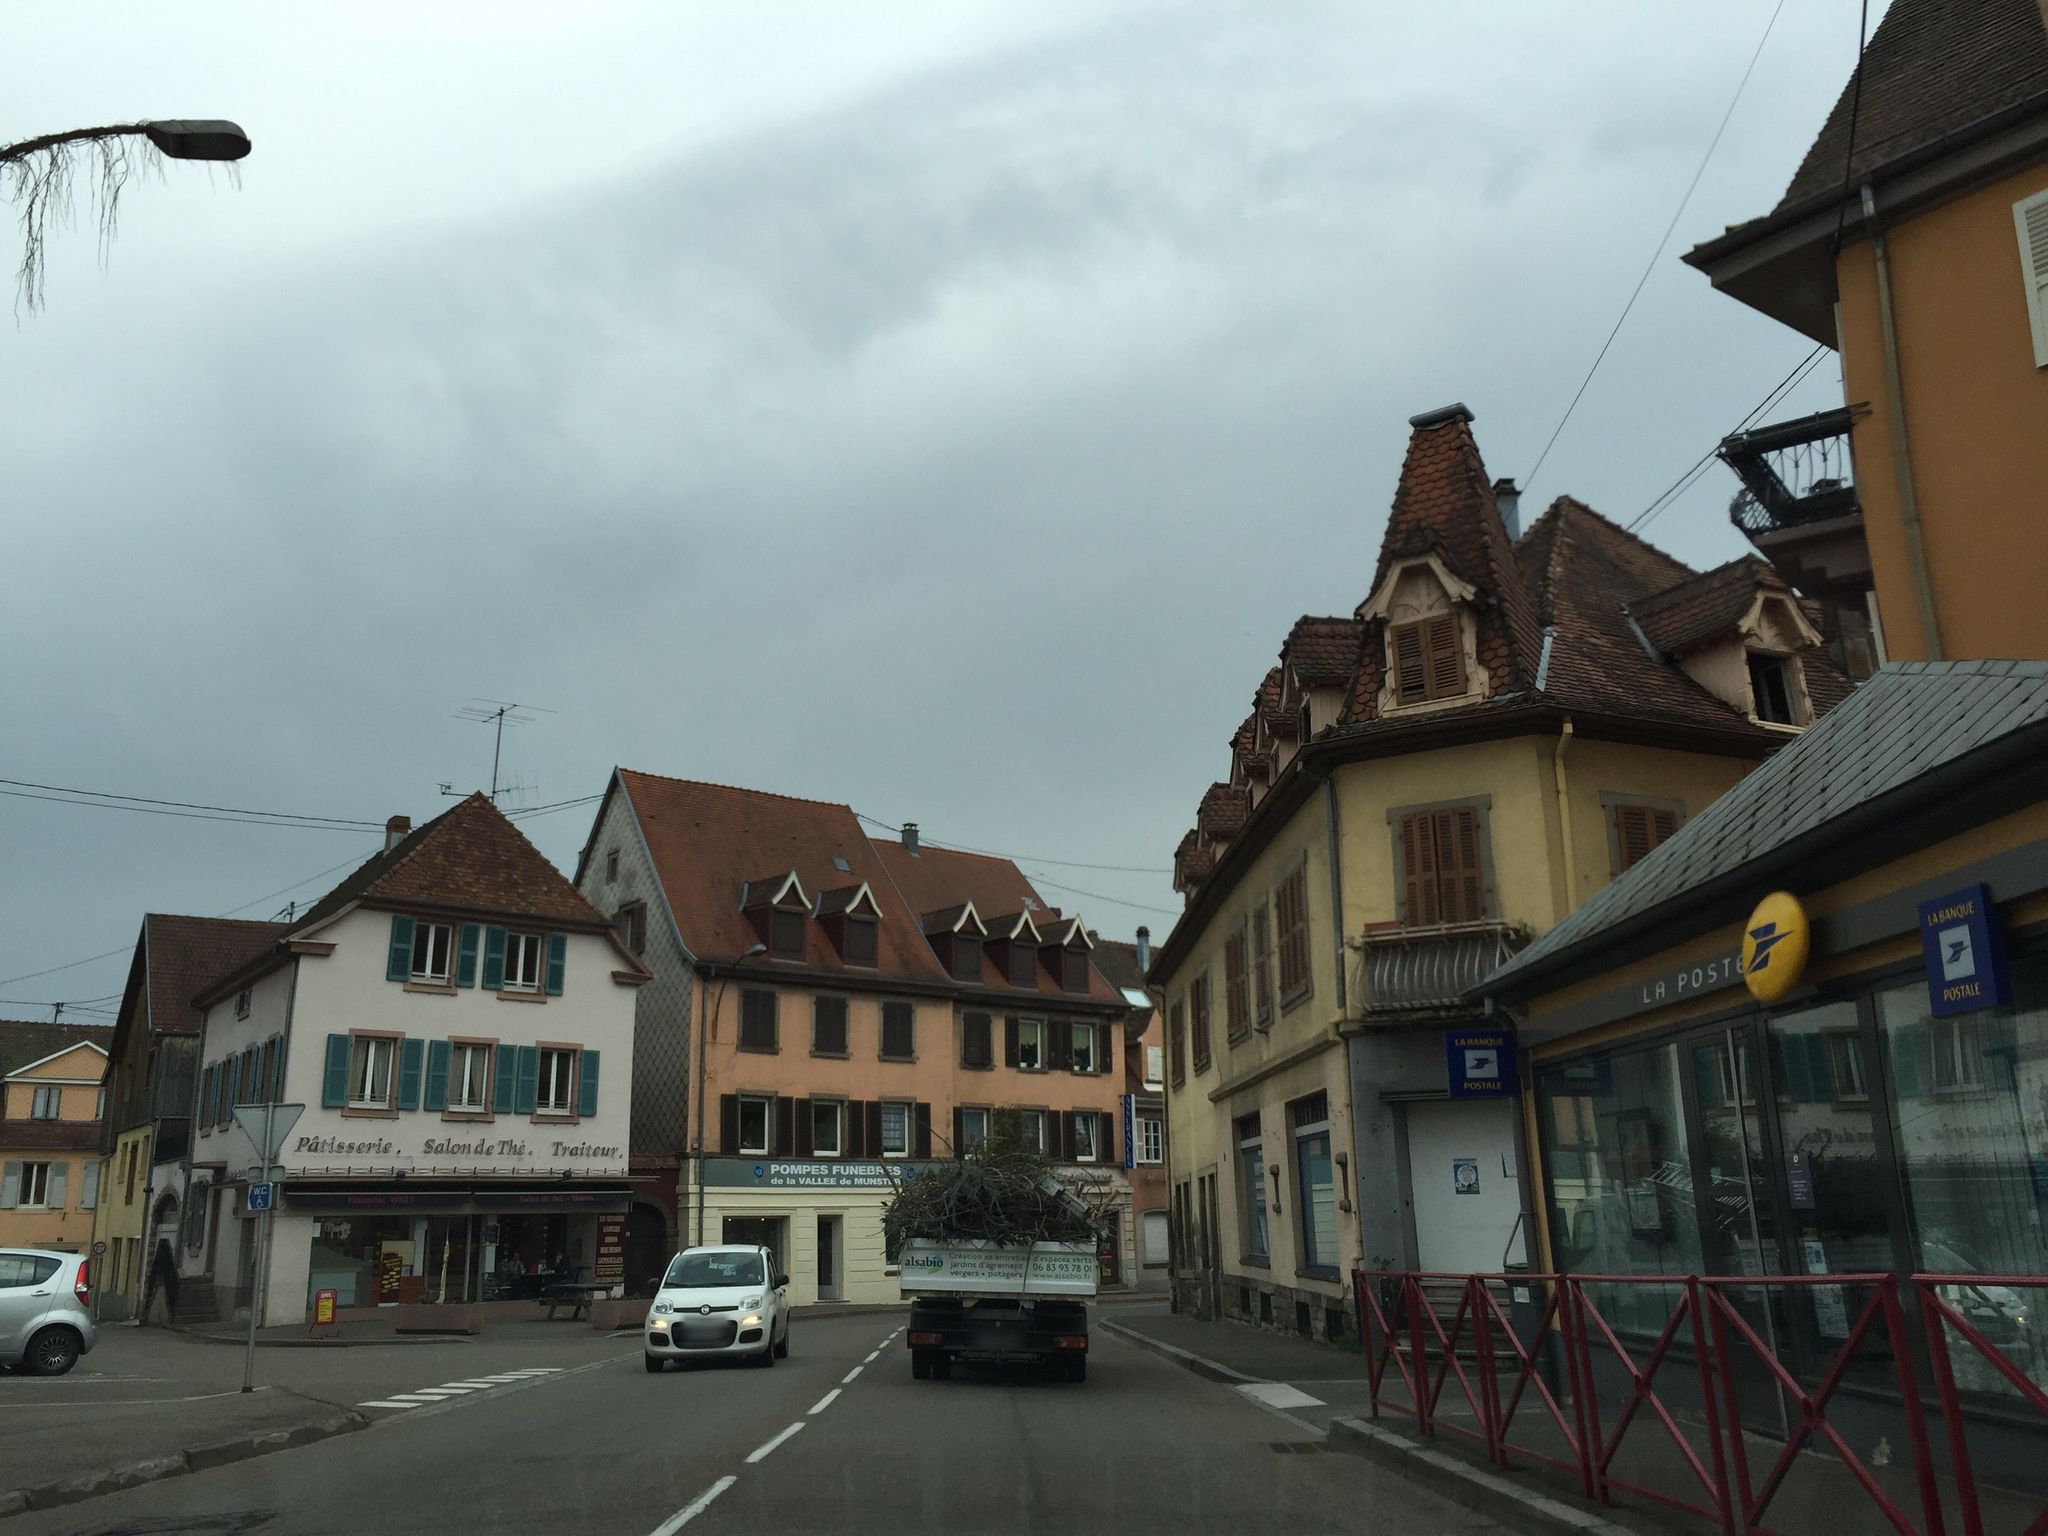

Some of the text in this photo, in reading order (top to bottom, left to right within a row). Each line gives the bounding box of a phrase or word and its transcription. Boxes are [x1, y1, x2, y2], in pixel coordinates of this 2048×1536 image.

[1928, 901, 1975, 926] LA BANQUE
[1642, 980, 1665, 1004] LA
[1943, 982, 1981, 1002] POSTALE
[1467, 1037, 1504, 1047] BANQUE
[1463, 1080, 1502, 1090] POSTALE
[423, 1138, 472, 1155] Salon
[474, 1138, 495, 1156] de
[770, 1164, 829, 1175] POMPES
[771, 1177, 784, 1185] de
[786, 1177, 796, 1185] la
[798, 1177, 837, 1186] VALLEE
[840, 1177, 852, 1186] de
[904, 1256, 944, 1267] alsabio
[1072, 1255, 1092, 1264] verts
[950, 1260, 977, 1269] jardins
[1032, 1262, 1044, 1271] 06
[1046, 1263, 1057, 1272] 83
[1058, 1263, 1069, 1272] 93
[1071, 1264, 1082, 1272] 78
[949, 1269, 979, 1278] vergers
[988, 1270, 1023, 1279] potagers
